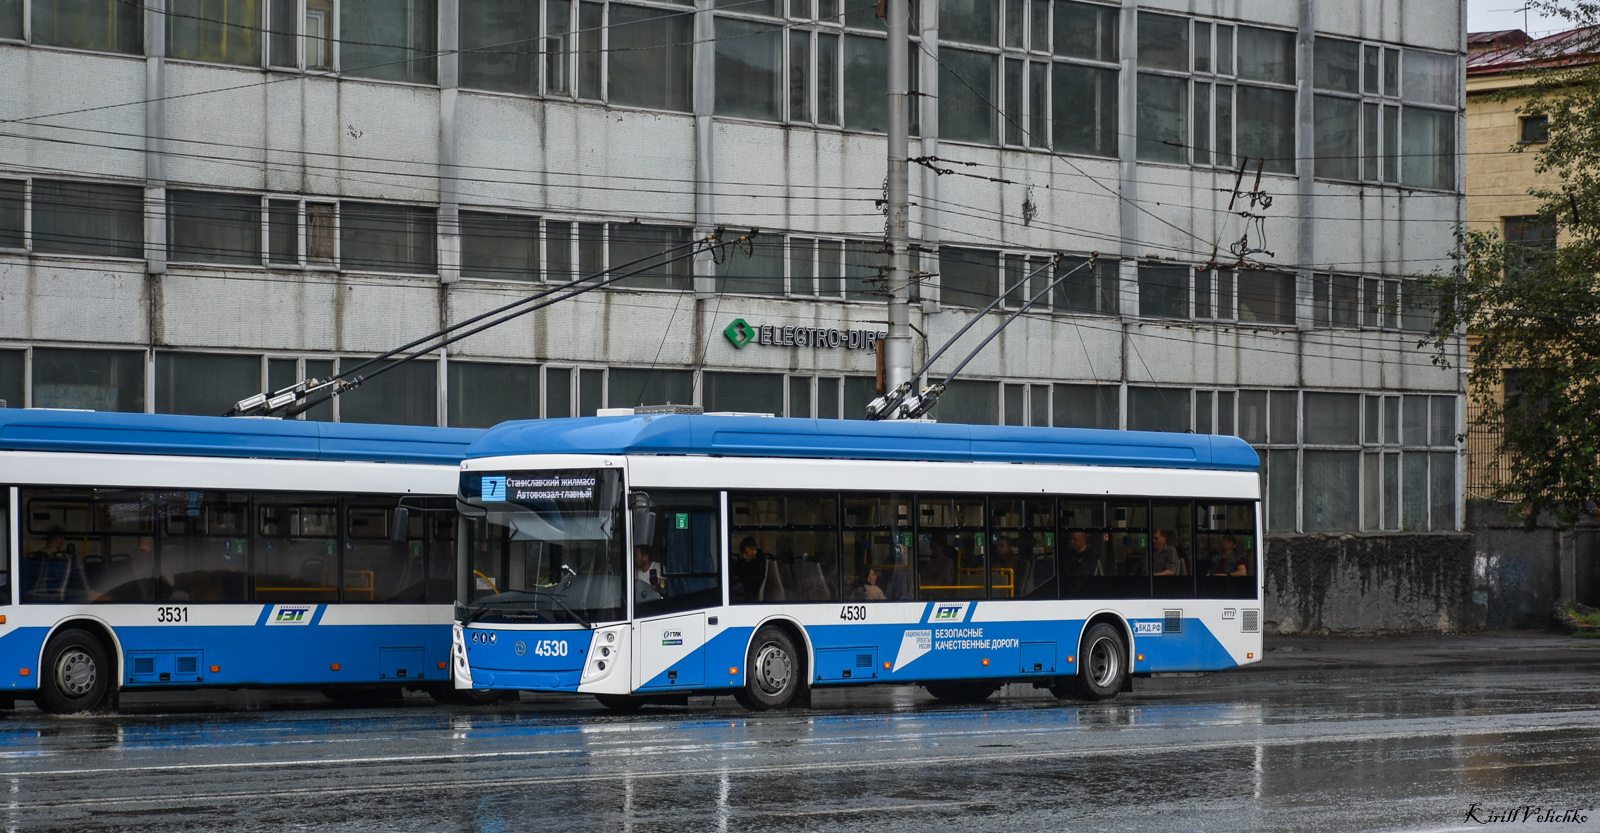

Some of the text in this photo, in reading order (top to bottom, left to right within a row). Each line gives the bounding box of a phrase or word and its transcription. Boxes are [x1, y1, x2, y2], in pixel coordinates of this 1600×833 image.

[489, 480, 498, 496] 7
[506, 475, 560, 487] Станиславский
[157, 606, 188, 623] 3531
[840, 605, 867, 621] 4530
[935, 628, 983, 639] БЕЗОПАСНЫЕ
[1139, 623, 1161, 632] БКД.РФ
[535, 640, 568, 657] 4530
[935, 638, 1019, 650] КАЧЕСТВЕННЫЕ ДОРОГИ
